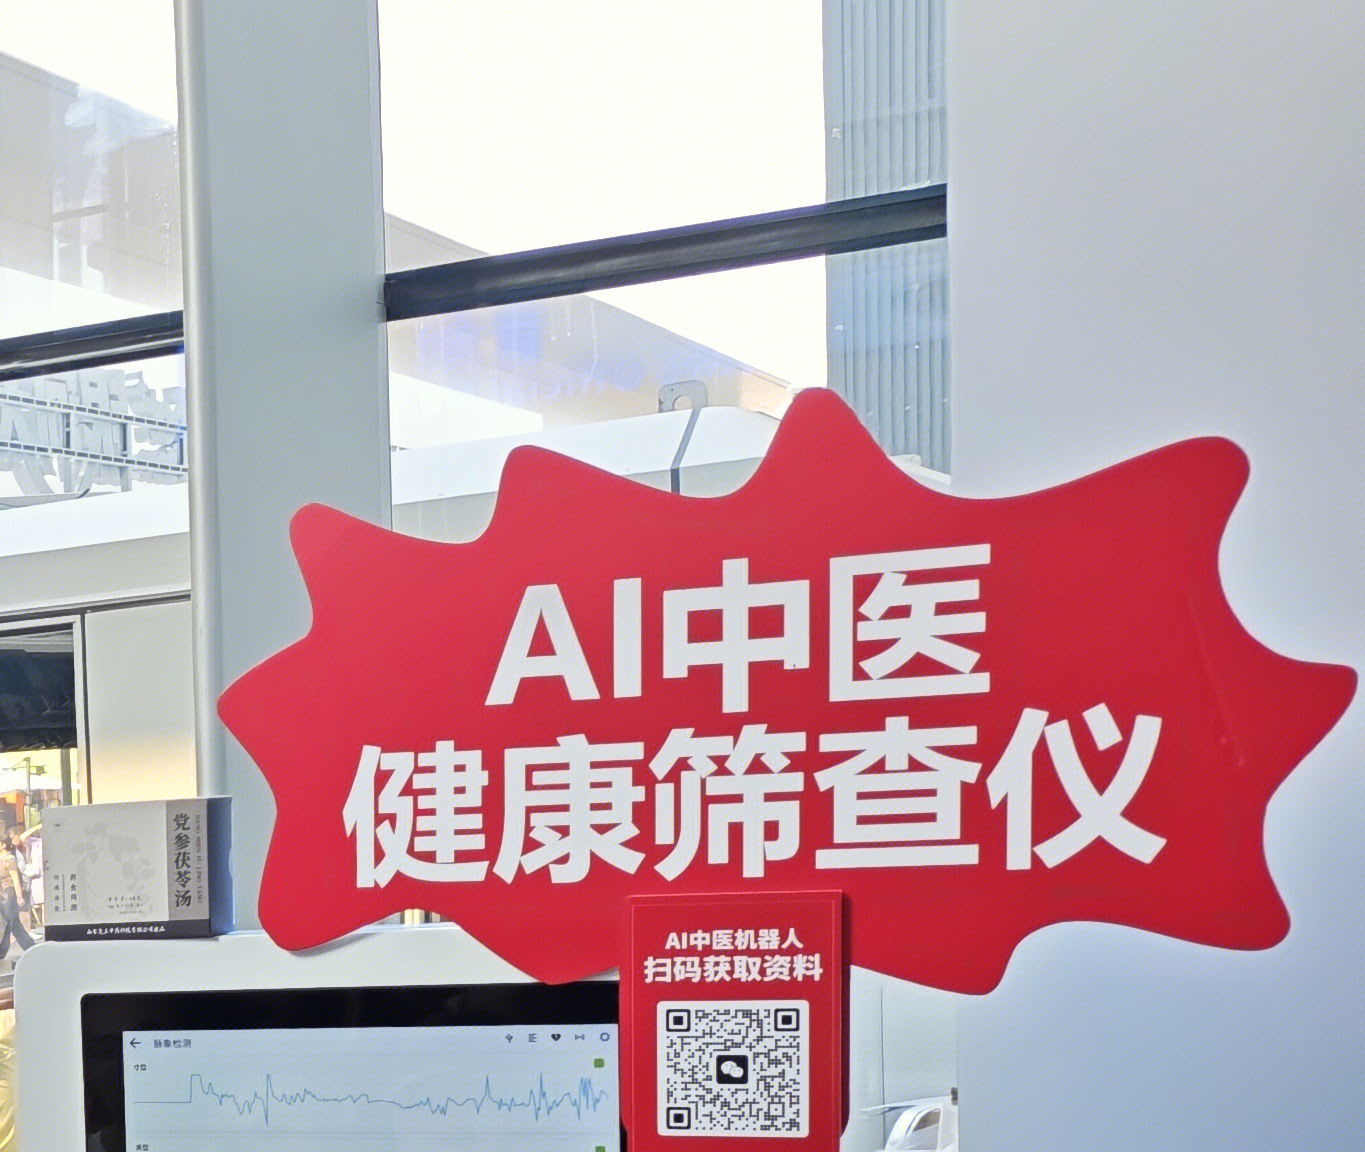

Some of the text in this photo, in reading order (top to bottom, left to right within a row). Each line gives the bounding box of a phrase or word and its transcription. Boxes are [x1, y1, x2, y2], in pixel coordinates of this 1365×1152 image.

[484, 543, 993, 715] AI中医
[342, 700, 1168, 890] 健康筛查仪
[173, 813, 193, 908] 党参茯苓汤
[644, 953, 823, 984] 扫码获取资料
[665, 928, 804, 951] AI中医机器人
